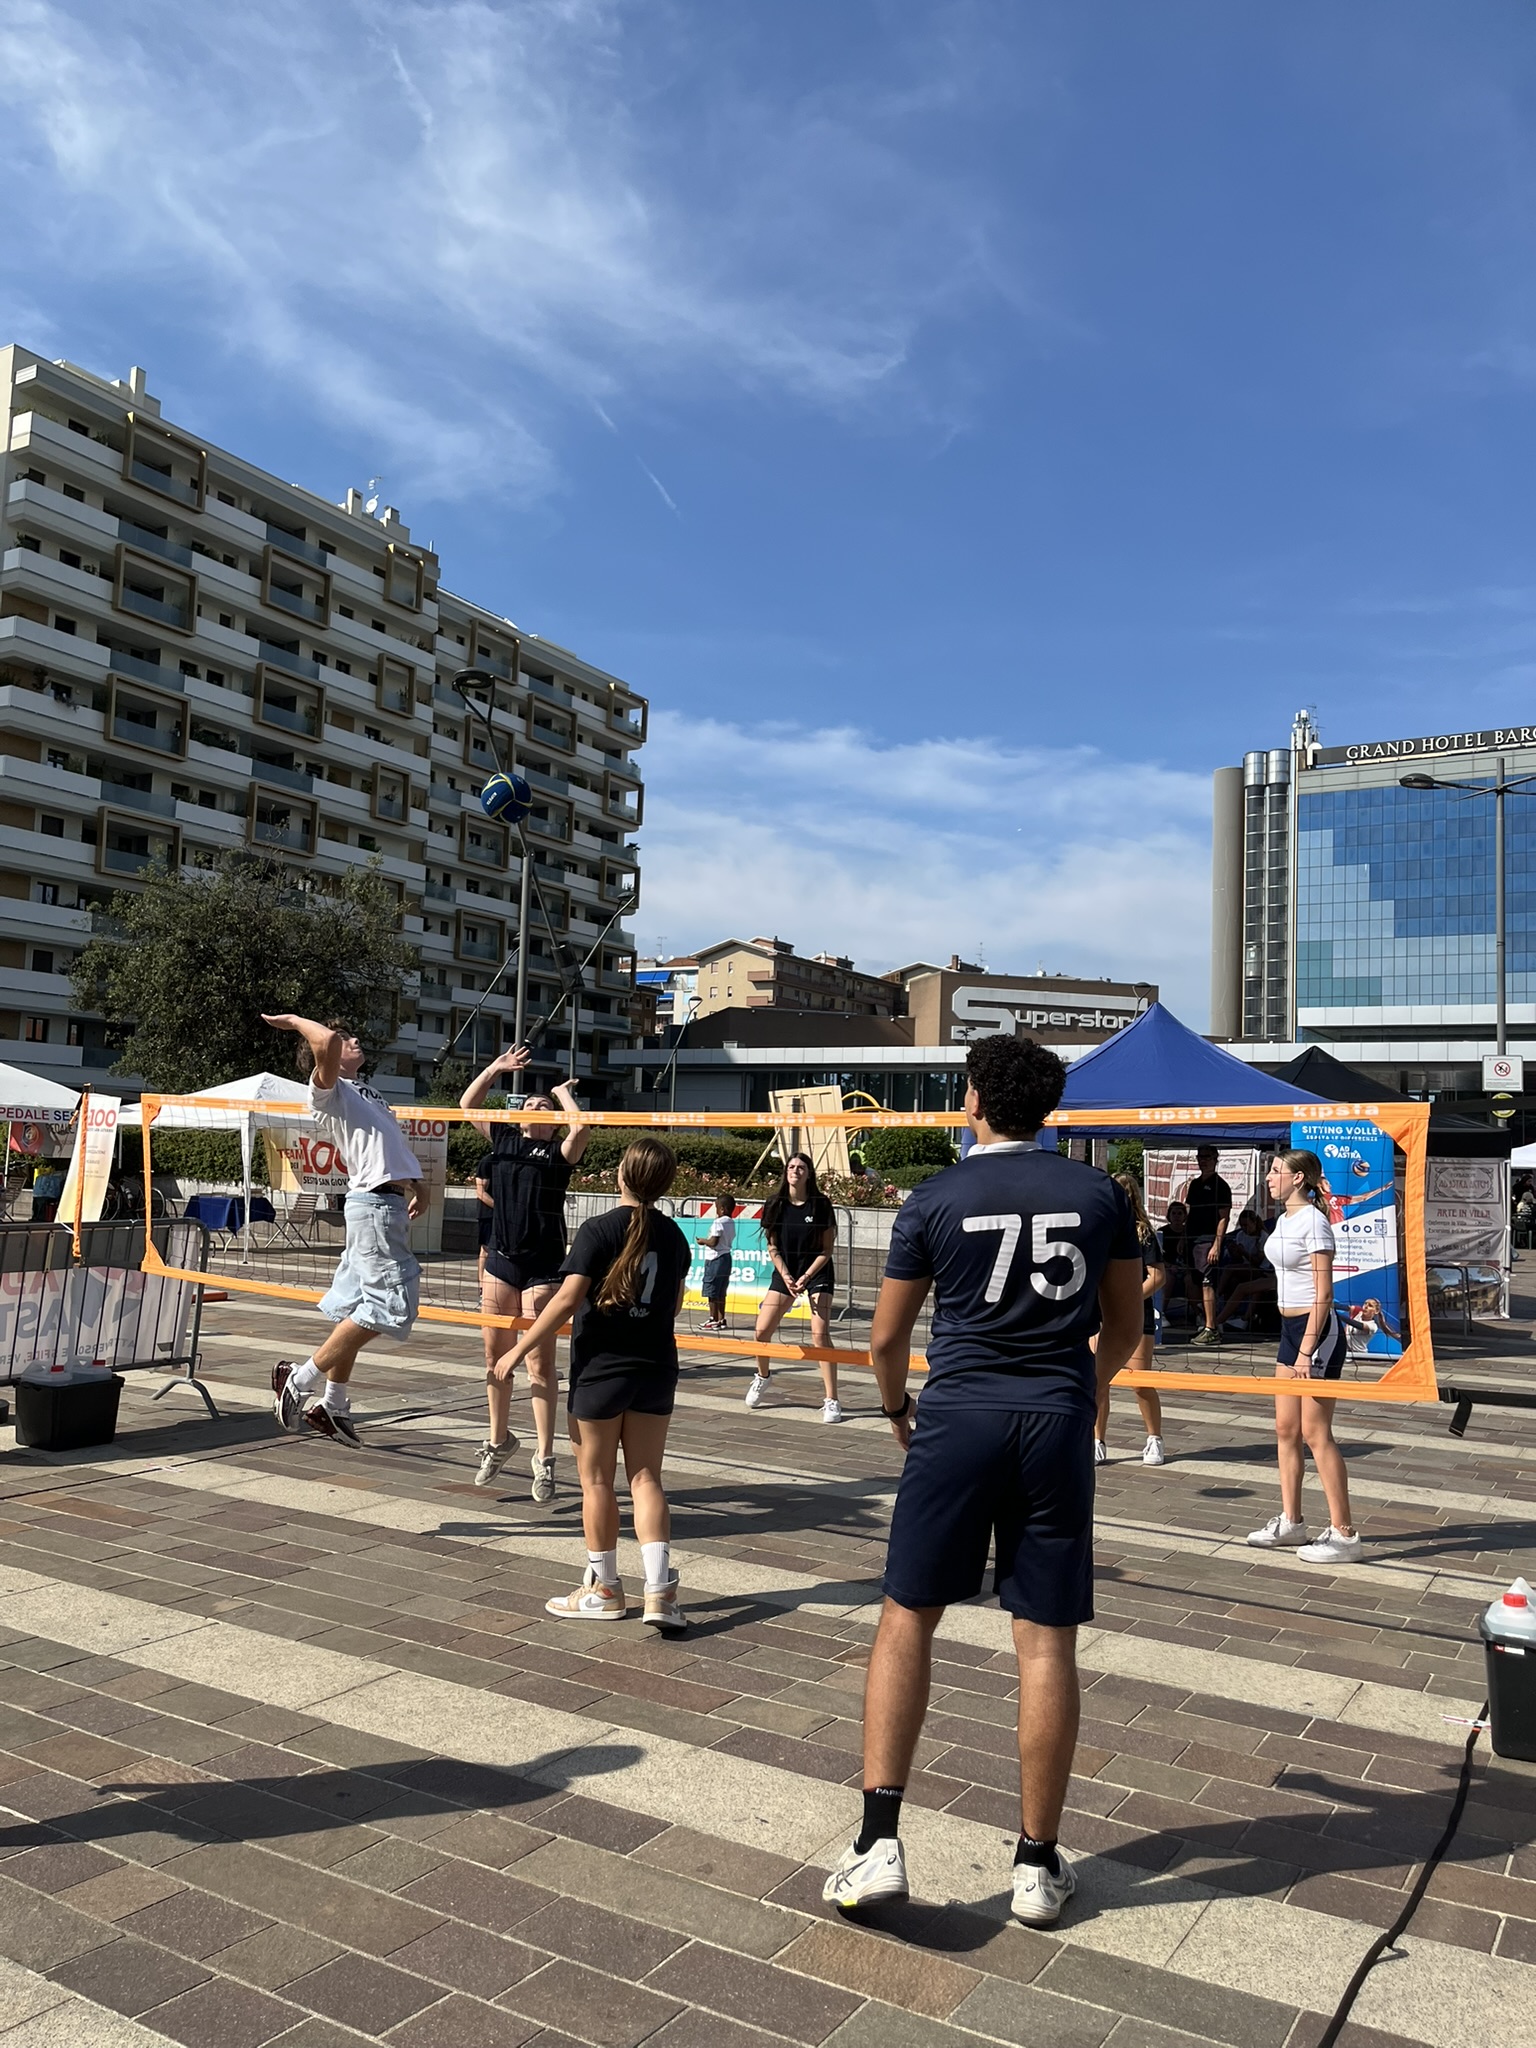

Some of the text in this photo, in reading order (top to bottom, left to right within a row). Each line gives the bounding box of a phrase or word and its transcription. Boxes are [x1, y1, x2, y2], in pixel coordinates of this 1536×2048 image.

[1346, 740, 1415, 759] GRAND
[1422, 732, 1486, 751] HOTEL
[951, 986, 1149, 1040] Superstor
[463, 1109, 510, 1120] kipsta
[554, 1112, 604, 1123] kipsta
[651, 1113, 705, 1123] kipsta
[1139, 1107, 1217, 1122] kipsta
[1293, 1104, 1379, 1119] kipsta
[757, 1115, 816, 1125] kipsta
[871, 1115, 936, 1126] kipsta
[410, 1119, 446, 1137] 100
[1302, 1126, 1384, 1135] SITTING VOLLEY
[1337, 1151, 1361, 1159] ASTRA
[730, 1249, 773, 1266] amp
[962, 1212, 1087, 1303] 75
